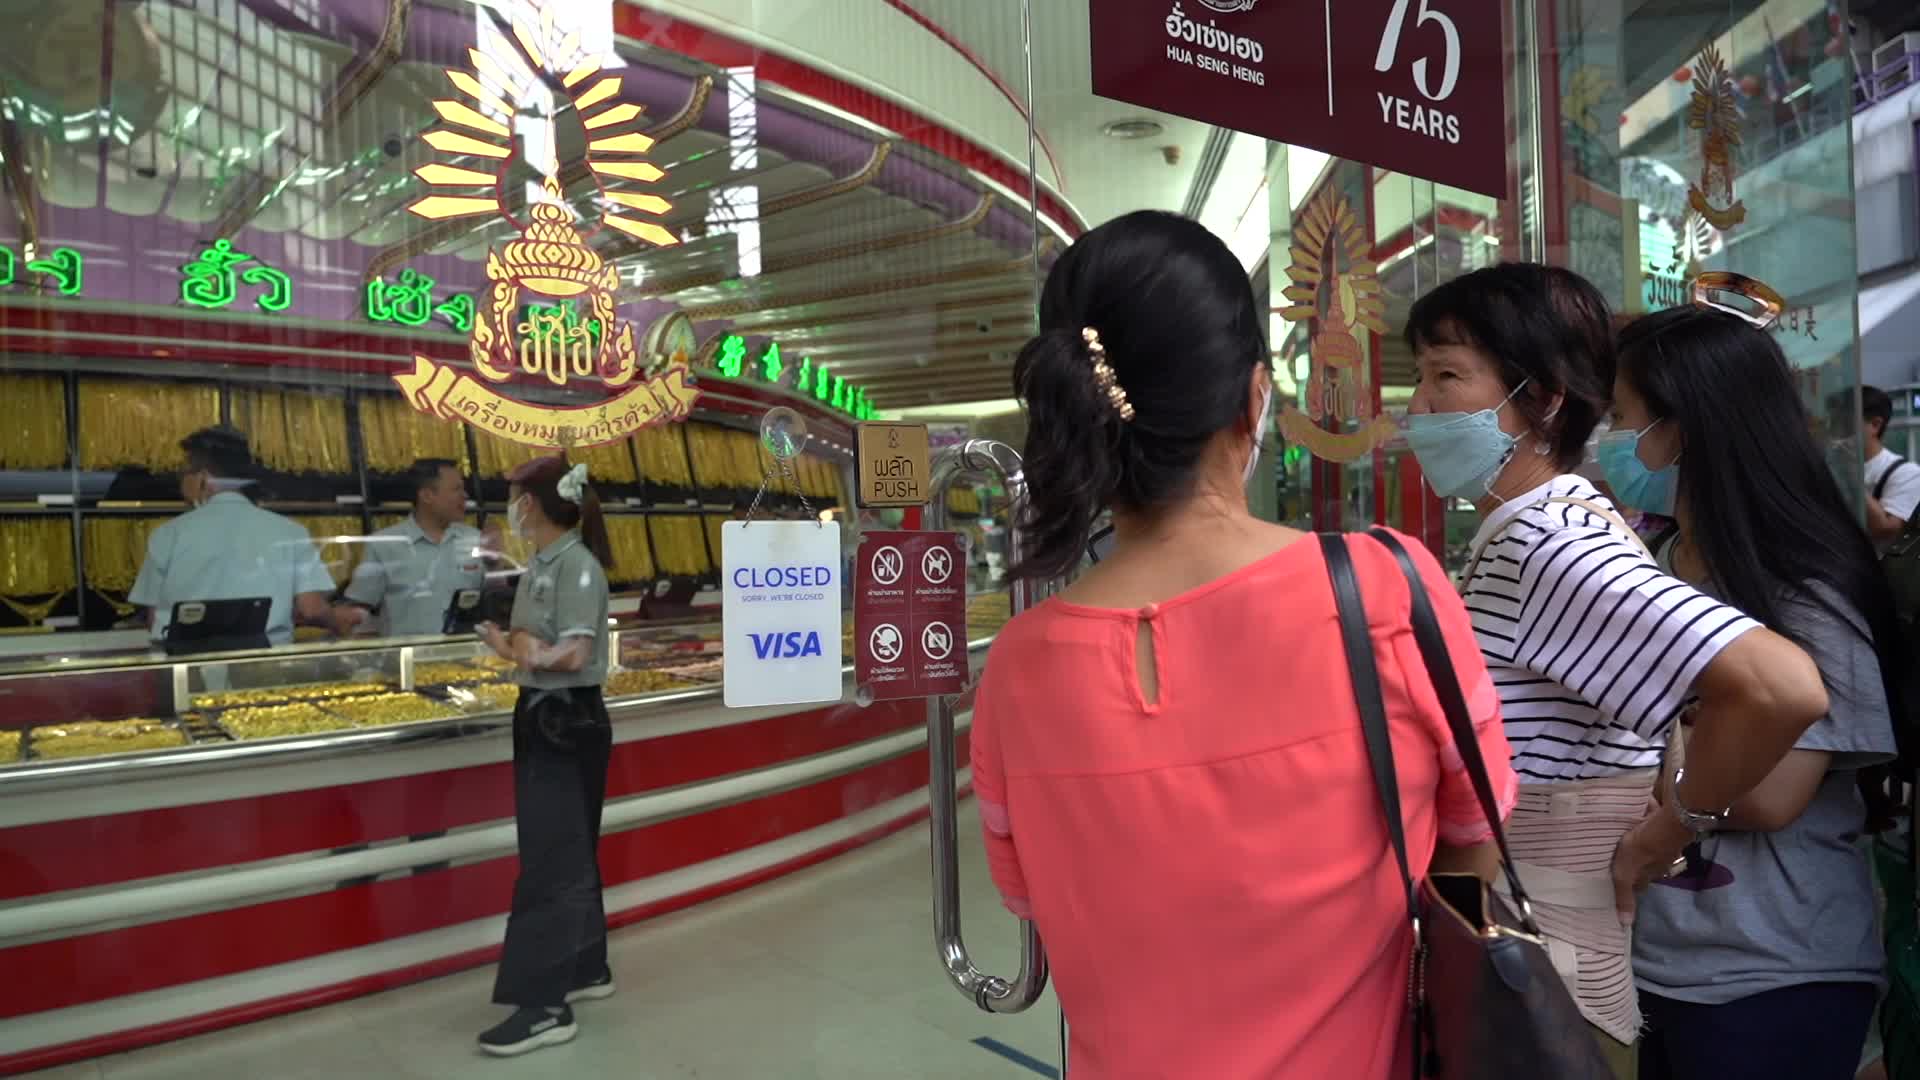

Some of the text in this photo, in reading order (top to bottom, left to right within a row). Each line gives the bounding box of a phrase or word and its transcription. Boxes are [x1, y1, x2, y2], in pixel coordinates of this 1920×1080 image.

[1166, 44, 1265, 86] HUA SENG HENG
[1377, 91, 1461, 144] YEARS
[873, 455, 914, 477] ผลัก
[873, 481, 919, 498] PUSH
[733, 566, 832, 589] CLOSED
[794, 592, 825, 601] CLOSED
[745, 631, 822, 660] VISA
